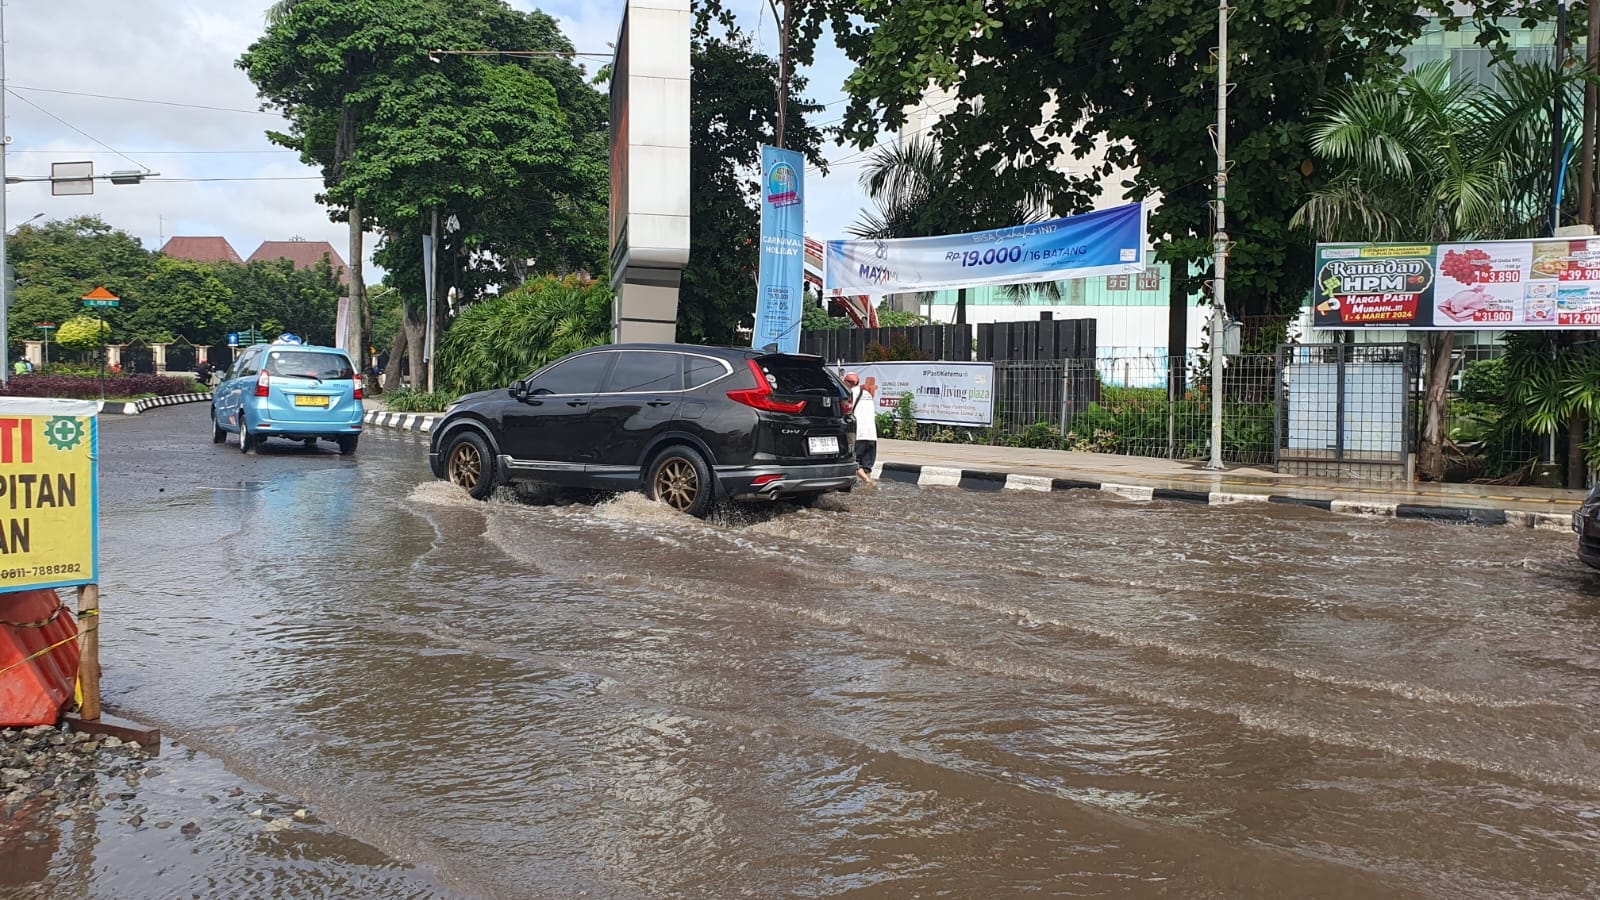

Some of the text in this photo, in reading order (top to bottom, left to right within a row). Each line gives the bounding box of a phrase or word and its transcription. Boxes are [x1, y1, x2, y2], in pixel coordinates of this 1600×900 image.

[973, 233, 995, 243] BISA
[1039, 224, 1057, 235] INI?
[762, 235, 802, 248] CARNAVAL
[765, 245, 798, 257] HOLIDAY
[1043, 245, 1087, 259] BATANG
[1330, 259, 1421, 276] Ramadan
[1489, 271, 1519, 282] 3.890
[1139, 280, 1157, 289] QLO
[1343, 276, 1404, 291] HPM
[1346, 292, 1413, 304] HARGA PASTI
[1362, 312, 1390, 320] MARET
[1391, 311, 1412, 319] 2024
[943, 384, 966, 401] living
[968, 387, 989, 400] plaza
